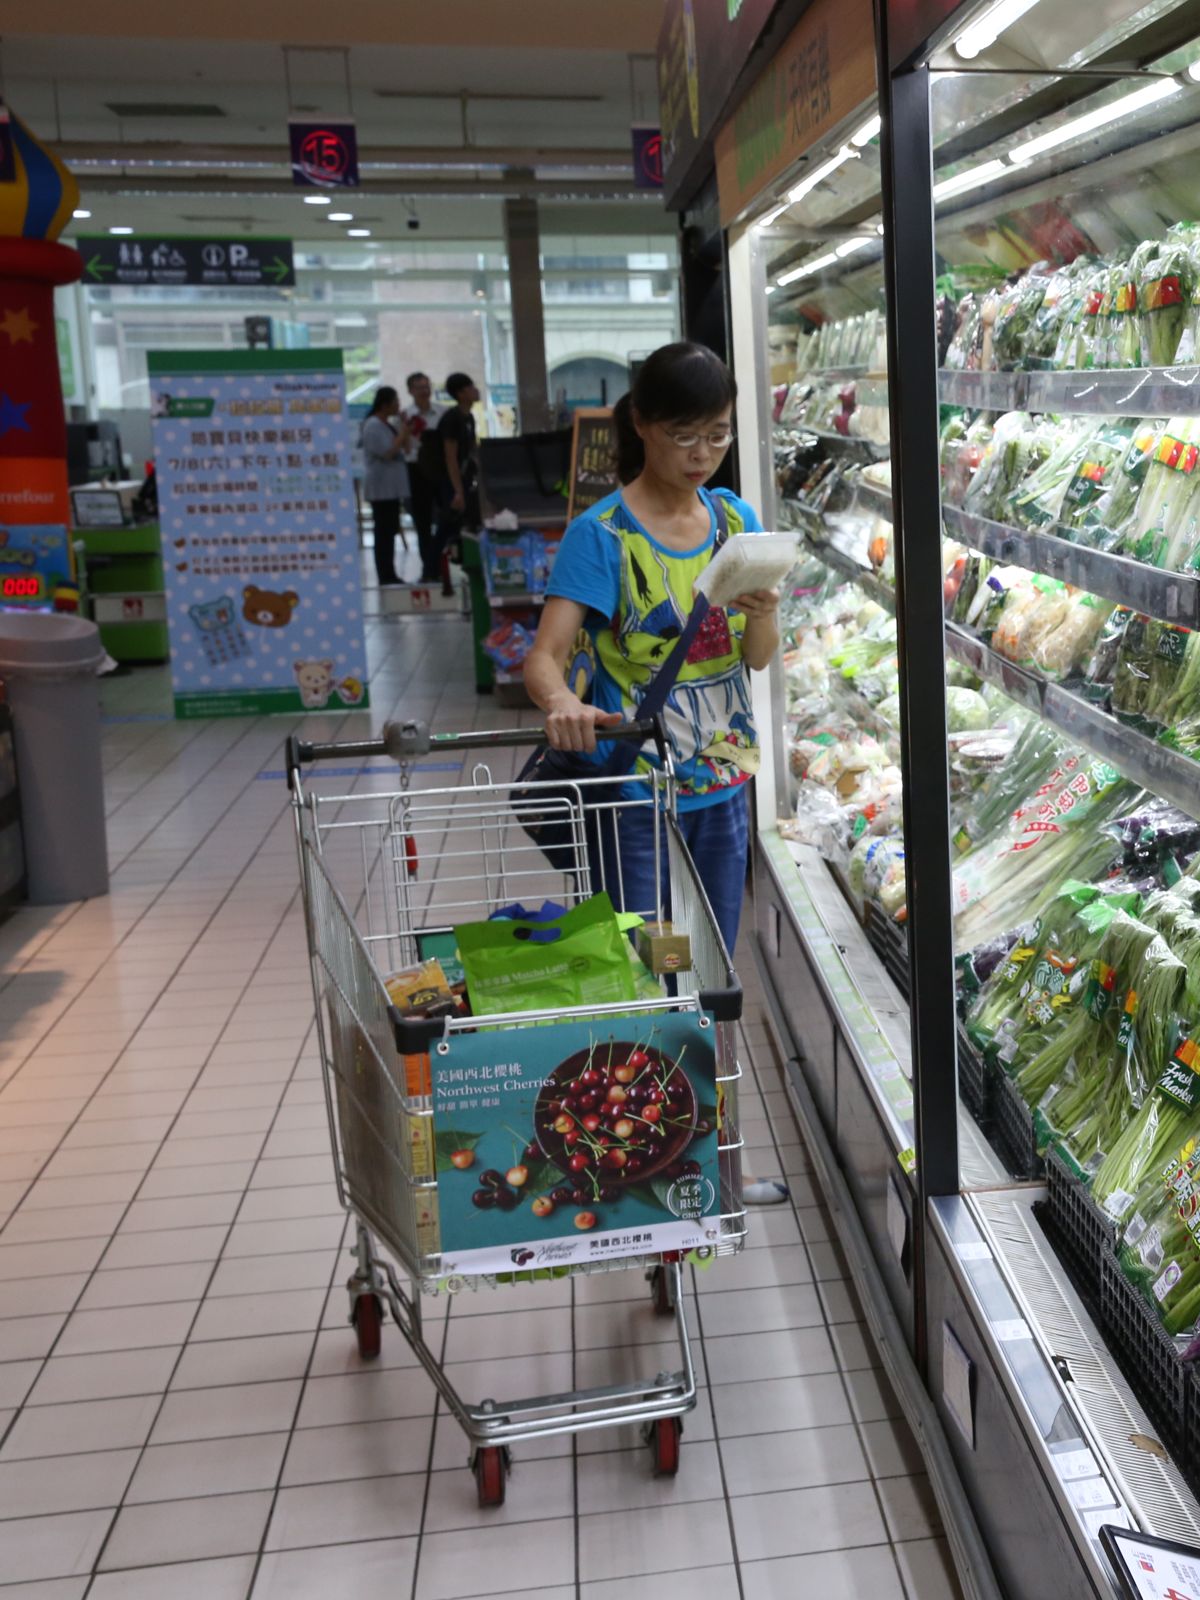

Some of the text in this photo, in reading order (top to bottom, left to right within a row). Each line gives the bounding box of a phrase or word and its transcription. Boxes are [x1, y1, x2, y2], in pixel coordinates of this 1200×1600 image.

[305, 138, 341, 171] 15
[437, 1062, 523, 1083] 美國西北櫻桃
[1163, 1060, 1196, 1087] Fresh
[436, 1076, 556, 1098] Northwest Cherries
